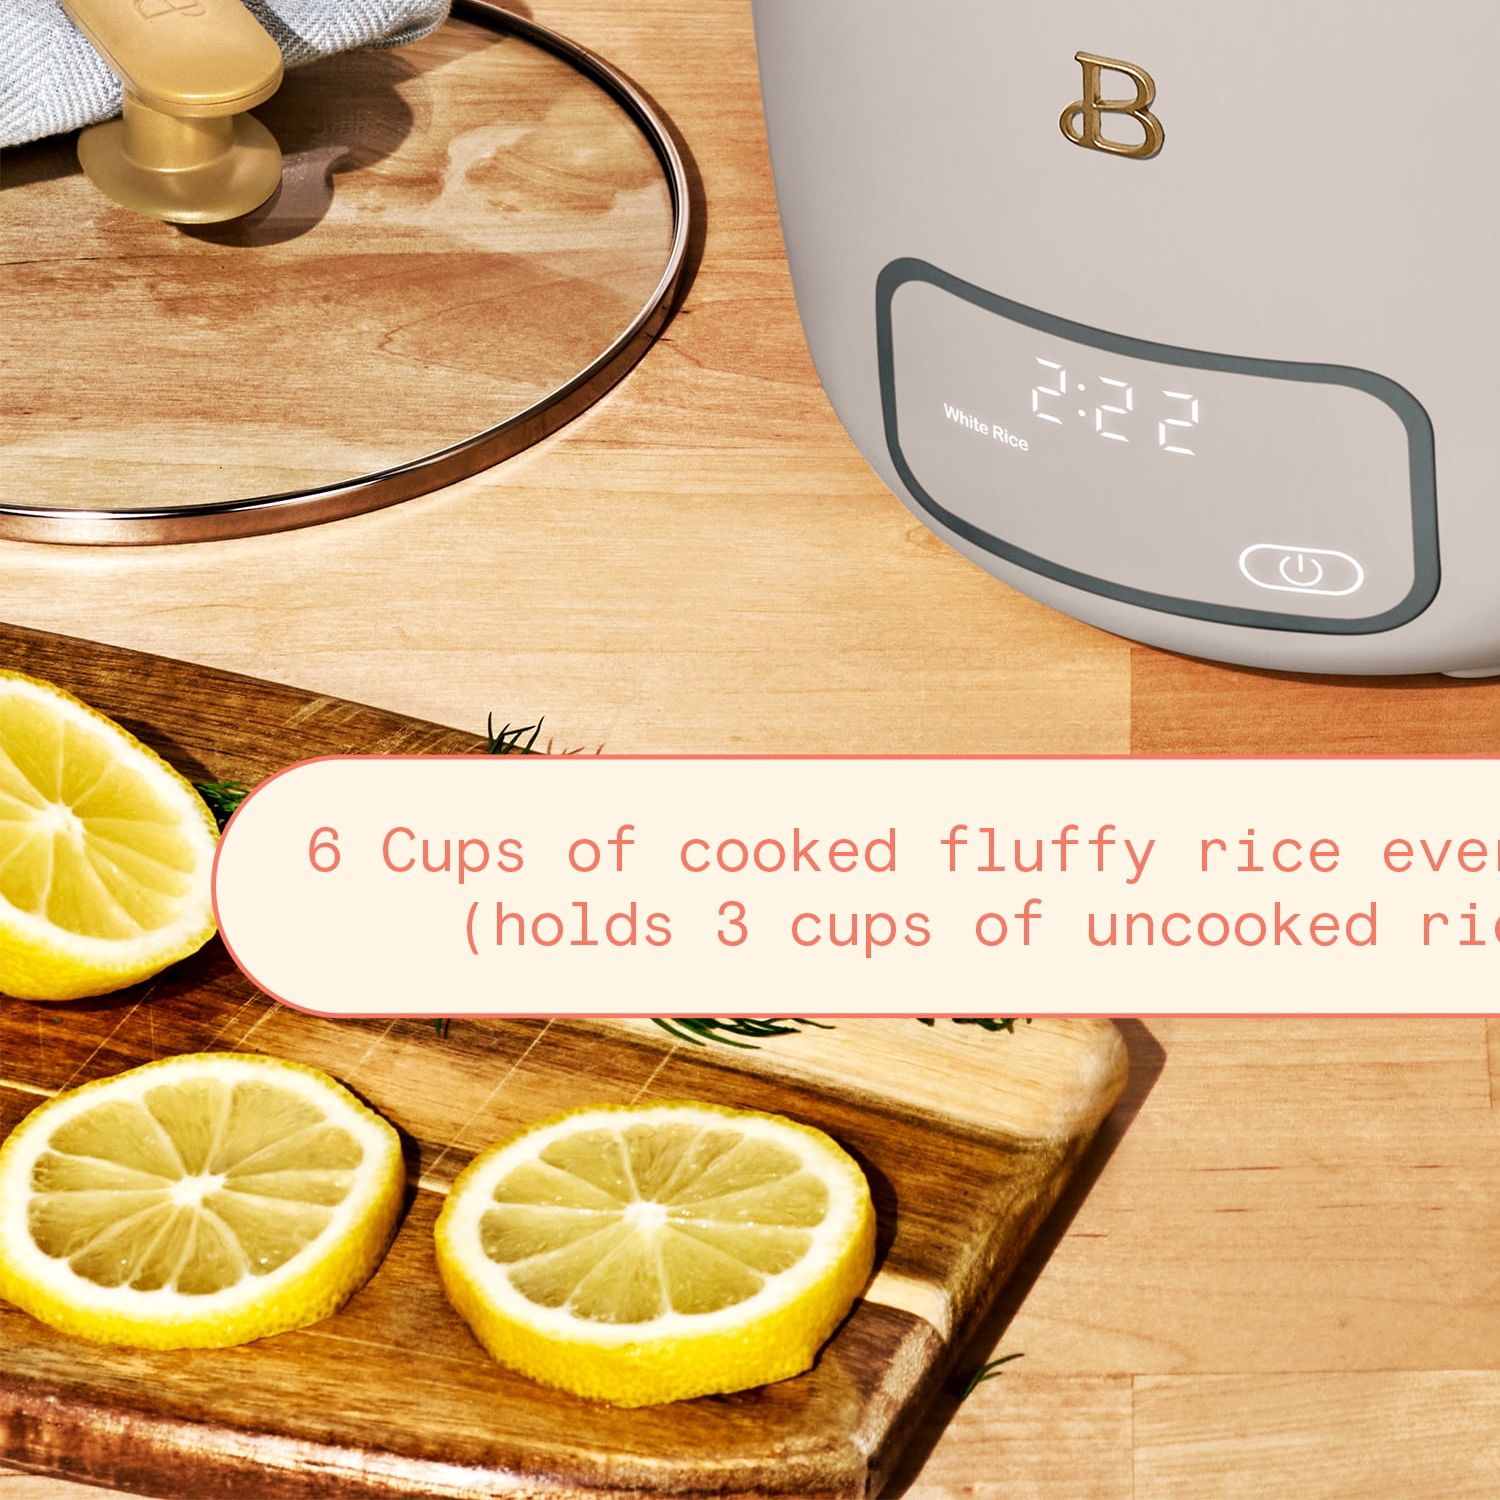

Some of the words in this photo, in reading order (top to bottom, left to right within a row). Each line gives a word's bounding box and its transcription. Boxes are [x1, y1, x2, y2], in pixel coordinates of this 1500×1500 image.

[1058, 51, 1165, 161] B
[943, 402, 989, 435] White
[992, 425, 1029, 451] Rice
[1032, 357, 1199, 456] 2:22
